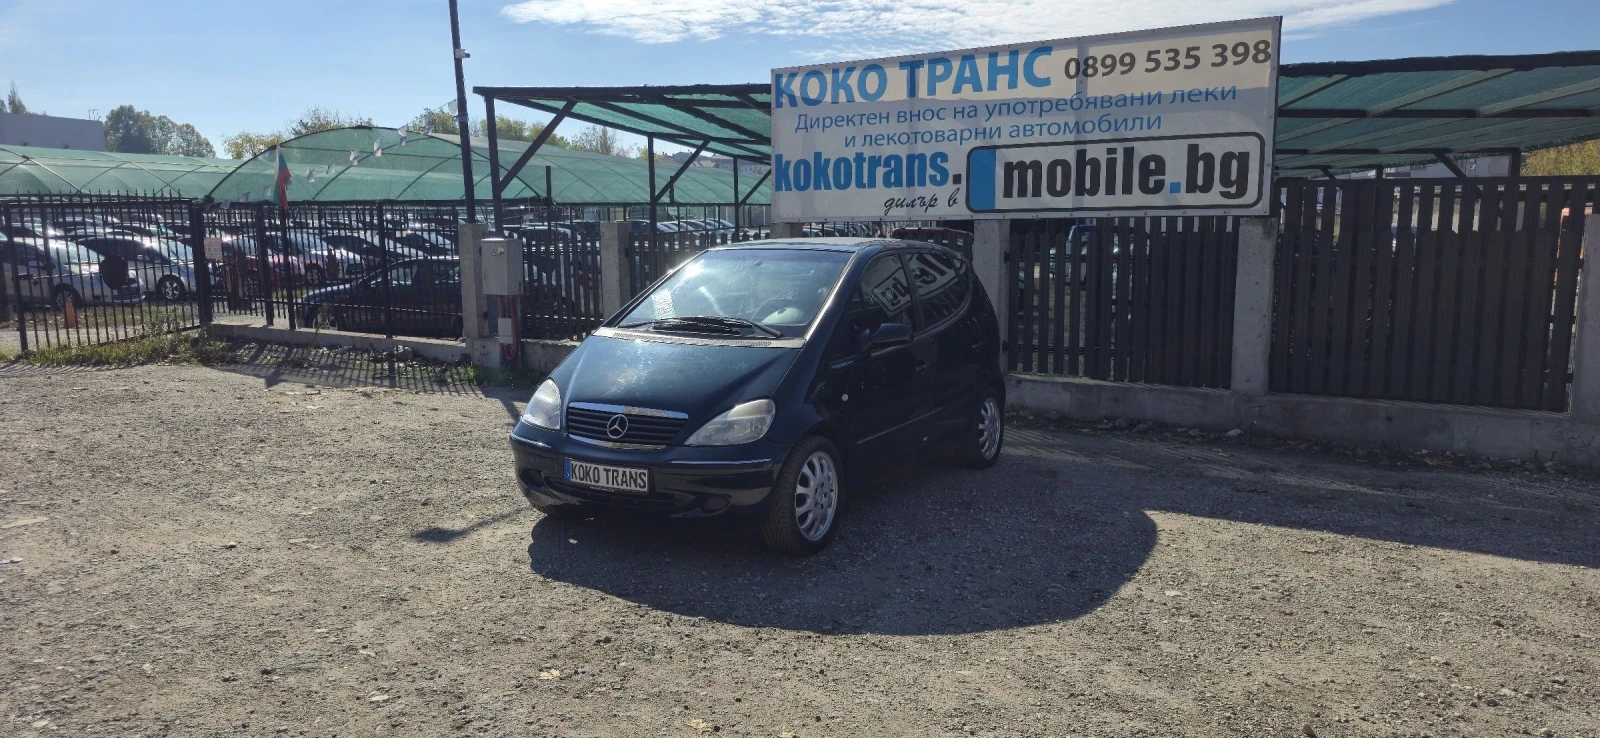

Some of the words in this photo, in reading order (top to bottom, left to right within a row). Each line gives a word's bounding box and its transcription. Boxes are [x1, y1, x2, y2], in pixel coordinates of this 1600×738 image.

[775, 63, 888, 109] КОКО
[899, 46, 1053, 99] ТРАНС
[1064, 52, 1136, 79] 0899
[1144, 46, 1201, 73] 535
[1210, 39, 1272, 68] 398
[795, 112, 890, 133] Директен
[897, 107, 947, 123] внос
[953, 104, 978, 119] на
[985, 91, 1162, 122] употребявани
[1169, 85, 1237, 105] леки
[844, 135, 856, 147] и
[861, 126, 1001, 147] лекотоварни
[1008, 113, 1162, 138] автомобили
[1003, 143, 1250, 199] mobile.bg
[884, 193, 939, 216] дилър
[571, 462, 600, 484] KOKO
[603, 468, 647, 489] TRANS
